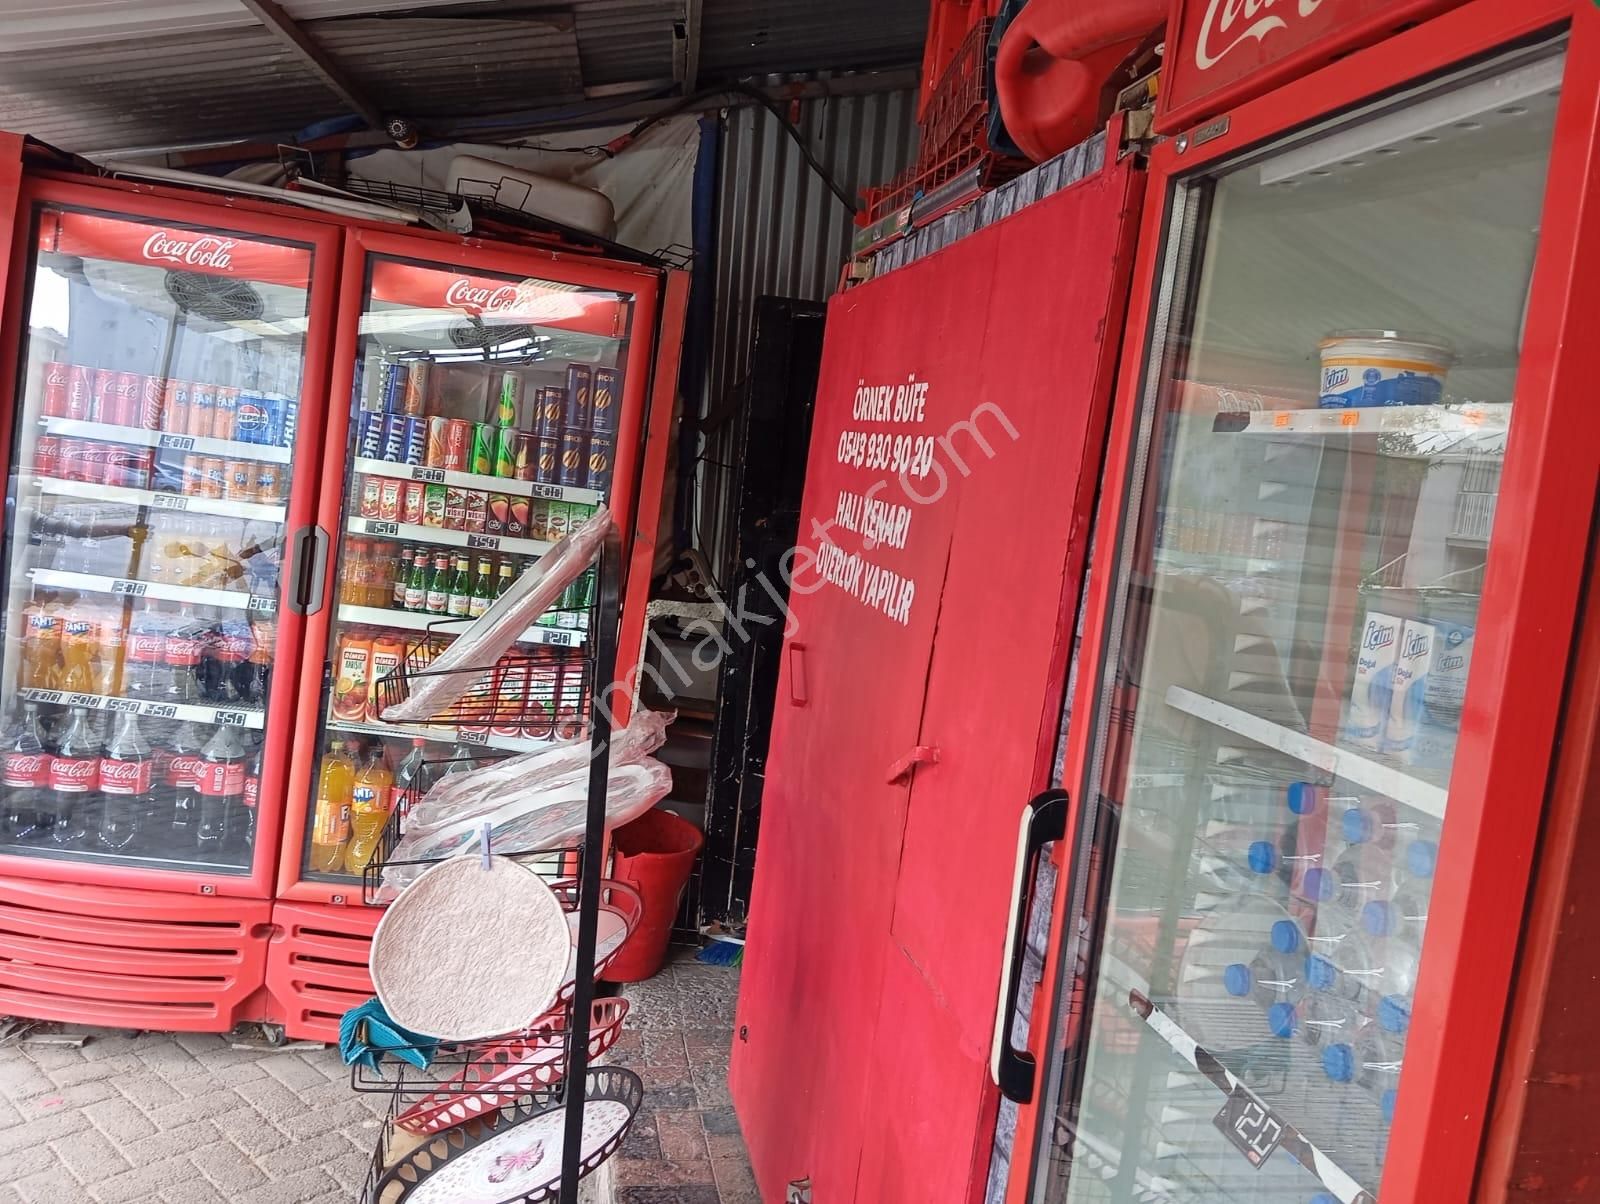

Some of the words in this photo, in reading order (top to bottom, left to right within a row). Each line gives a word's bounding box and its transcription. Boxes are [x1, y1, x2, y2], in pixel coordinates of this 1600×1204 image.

[143, 232, 239, 269] Coca-Cola
[852, 379, 894, 422] ÖRNEK
[892, 374, 929, 423] BÜFE
[838, 431, 867, 469] 0543
[866, 433, 892, 471] 930
[890, 434, 912, 474] 90
[910, 436, 935, 480] 20
[835, 490, 864, 533] HALI
[861, 497, 912, 550] KENARI
[816, 541, 864, 598] OVERLOK
[860, 561, 915, 626] YAPILIR
[50, 758, 96, 778] Coca-Cola
